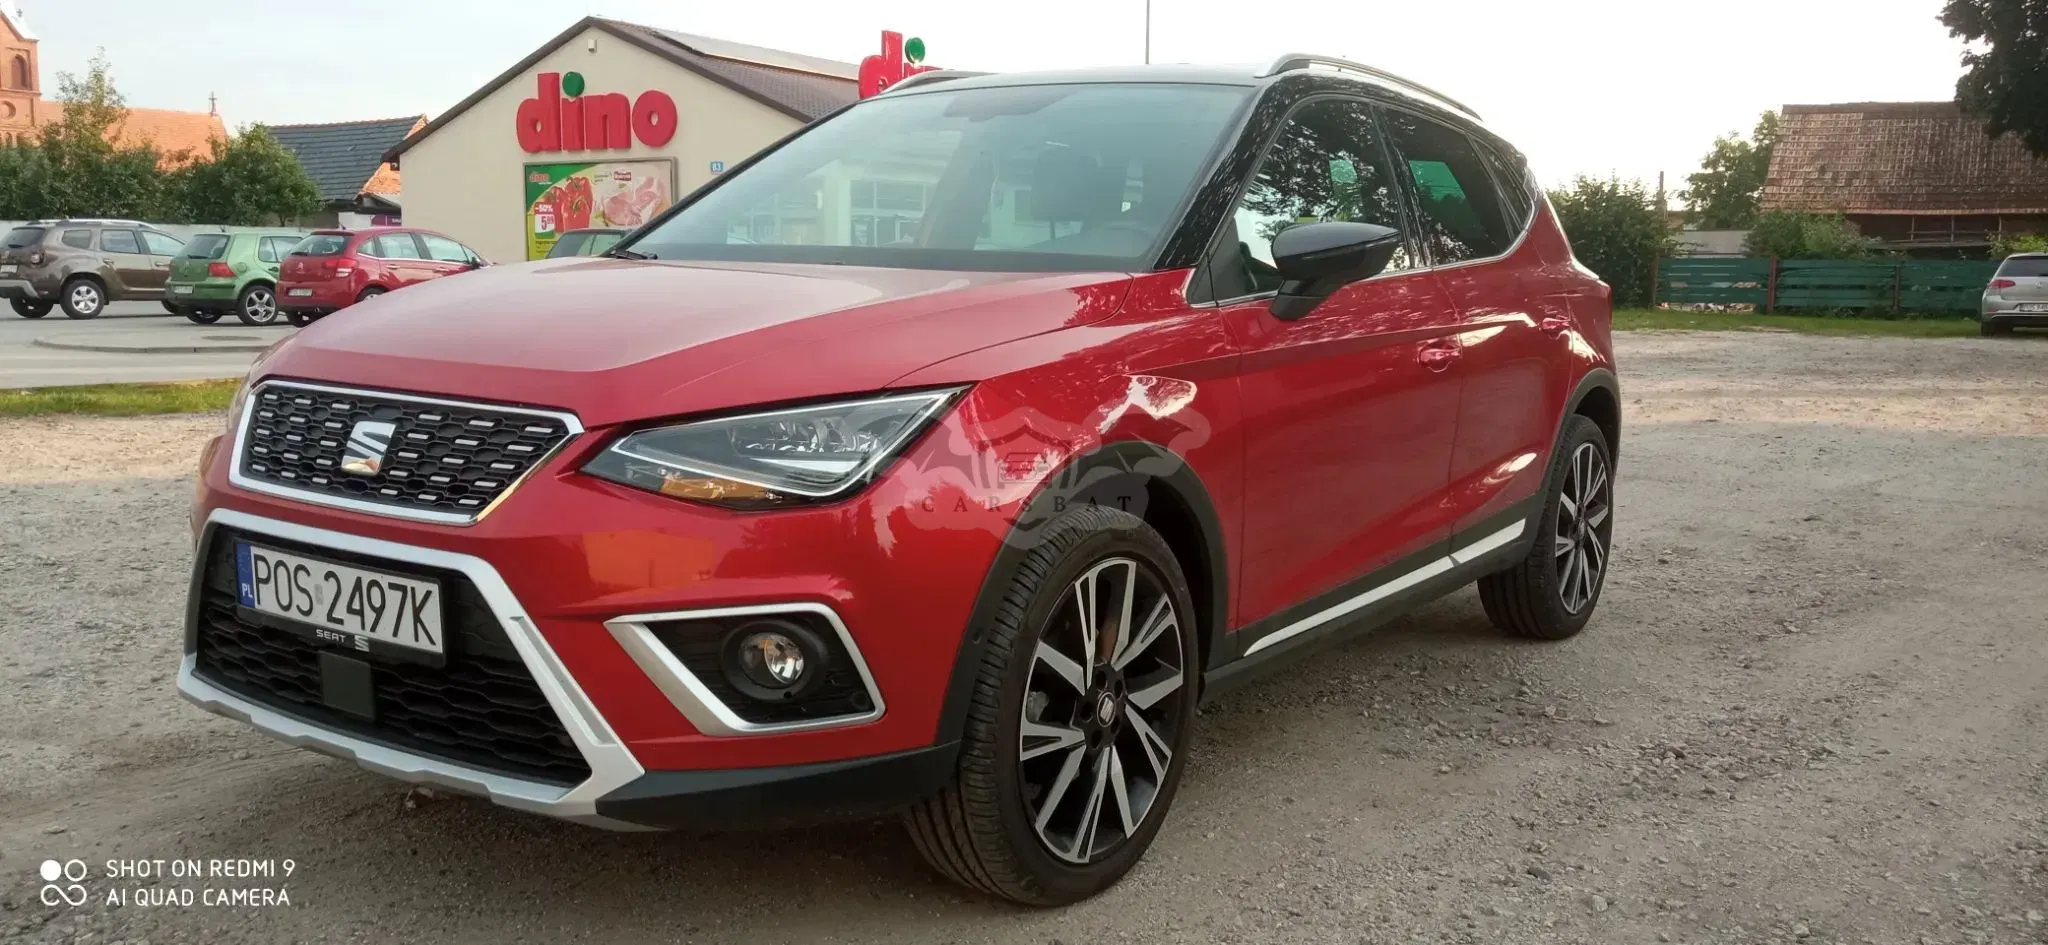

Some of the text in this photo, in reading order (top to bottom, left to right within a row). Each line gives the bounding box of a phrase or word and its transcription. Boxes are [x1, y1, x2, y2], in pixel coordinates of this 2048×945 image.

[516, 71, 677, 153] dino
[241, 583, 253, 599] PL
[254, 553, 436, 646] POS 2497K
[316, 629, 346, 643] SEAT
